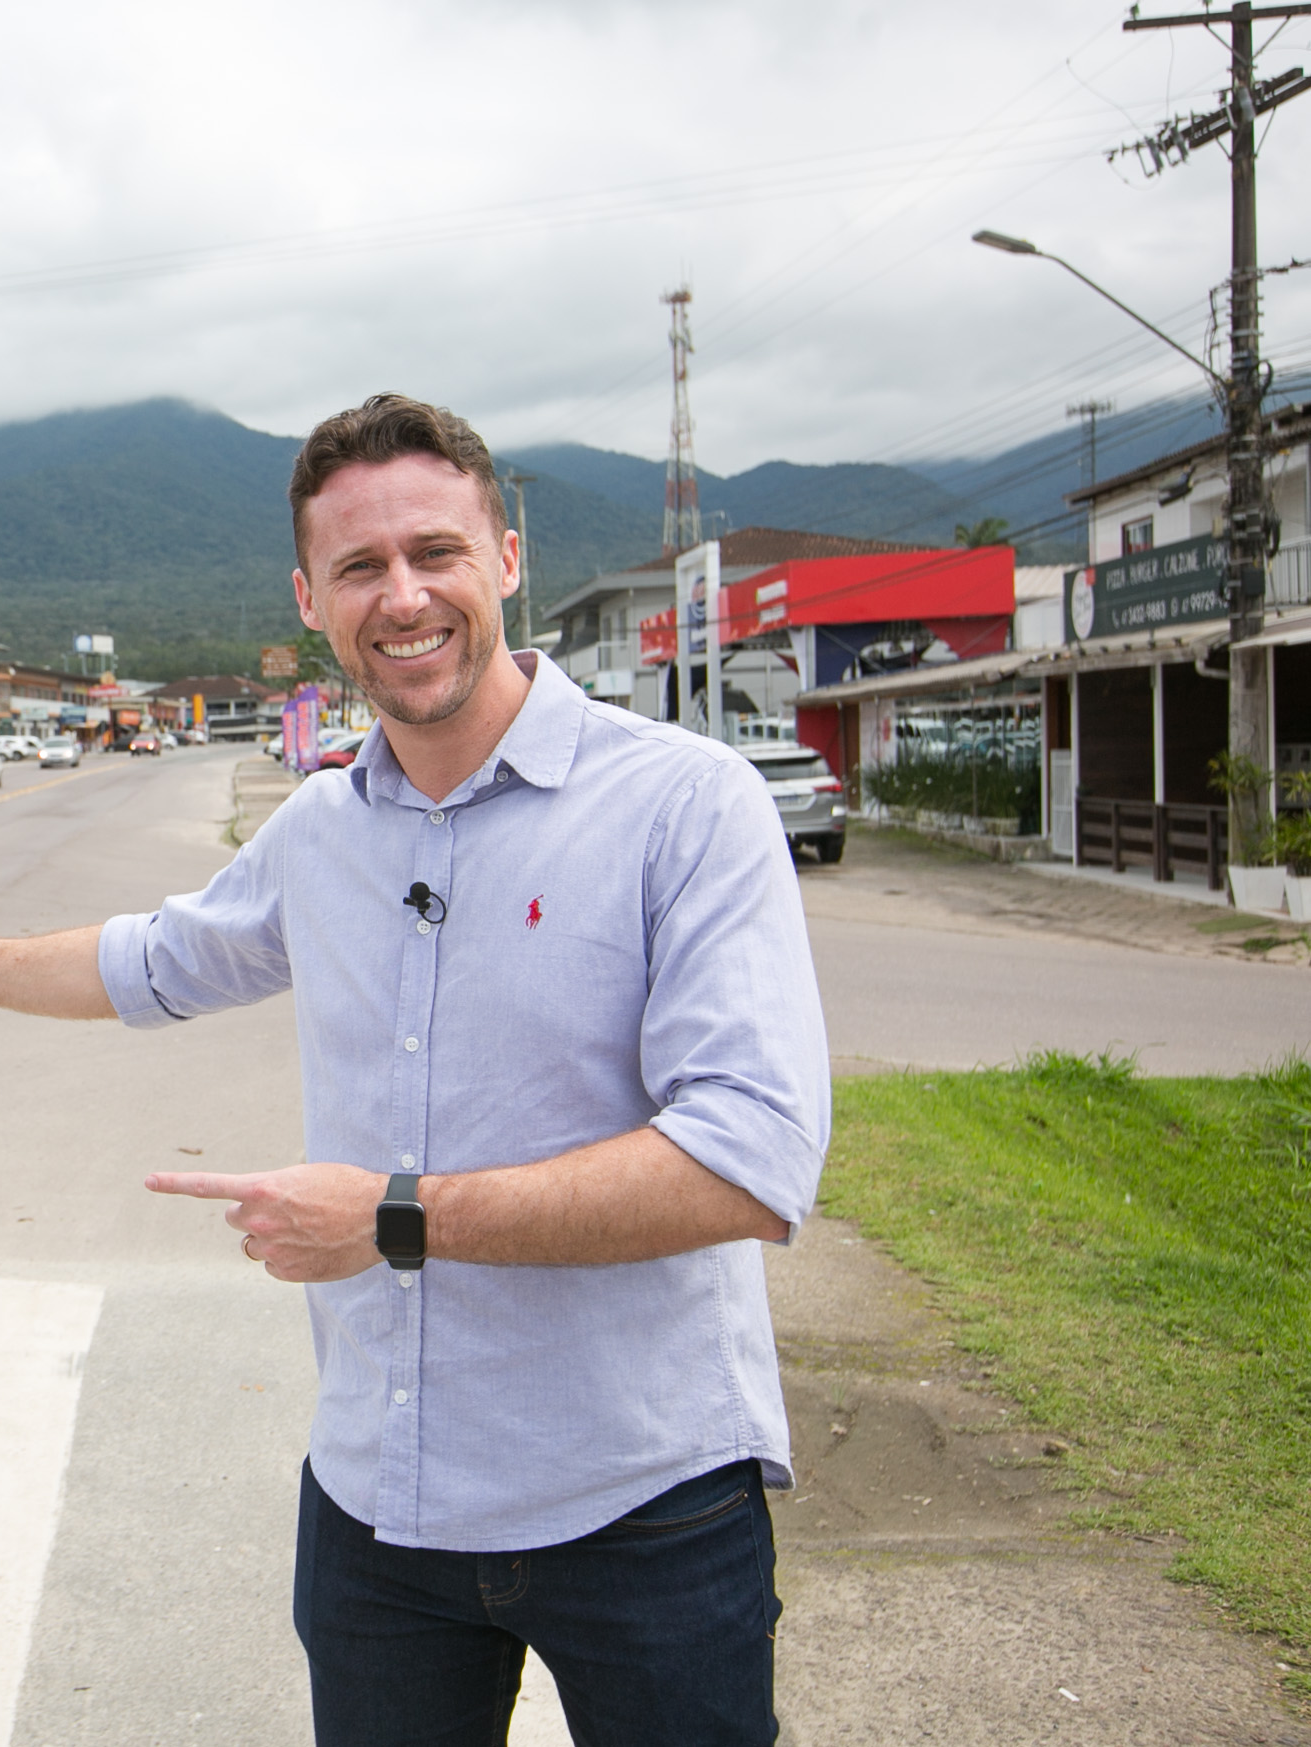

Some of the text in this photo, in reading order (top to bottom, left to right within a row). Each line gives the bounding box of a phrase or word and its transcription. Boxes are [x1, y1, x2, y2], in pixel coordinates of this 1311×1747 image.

[1106, 566, 1125, 591] PIZZA
[1130, 559, 1158, 585] BURGER
[1164, 548, 1200, 577] CALZONE
